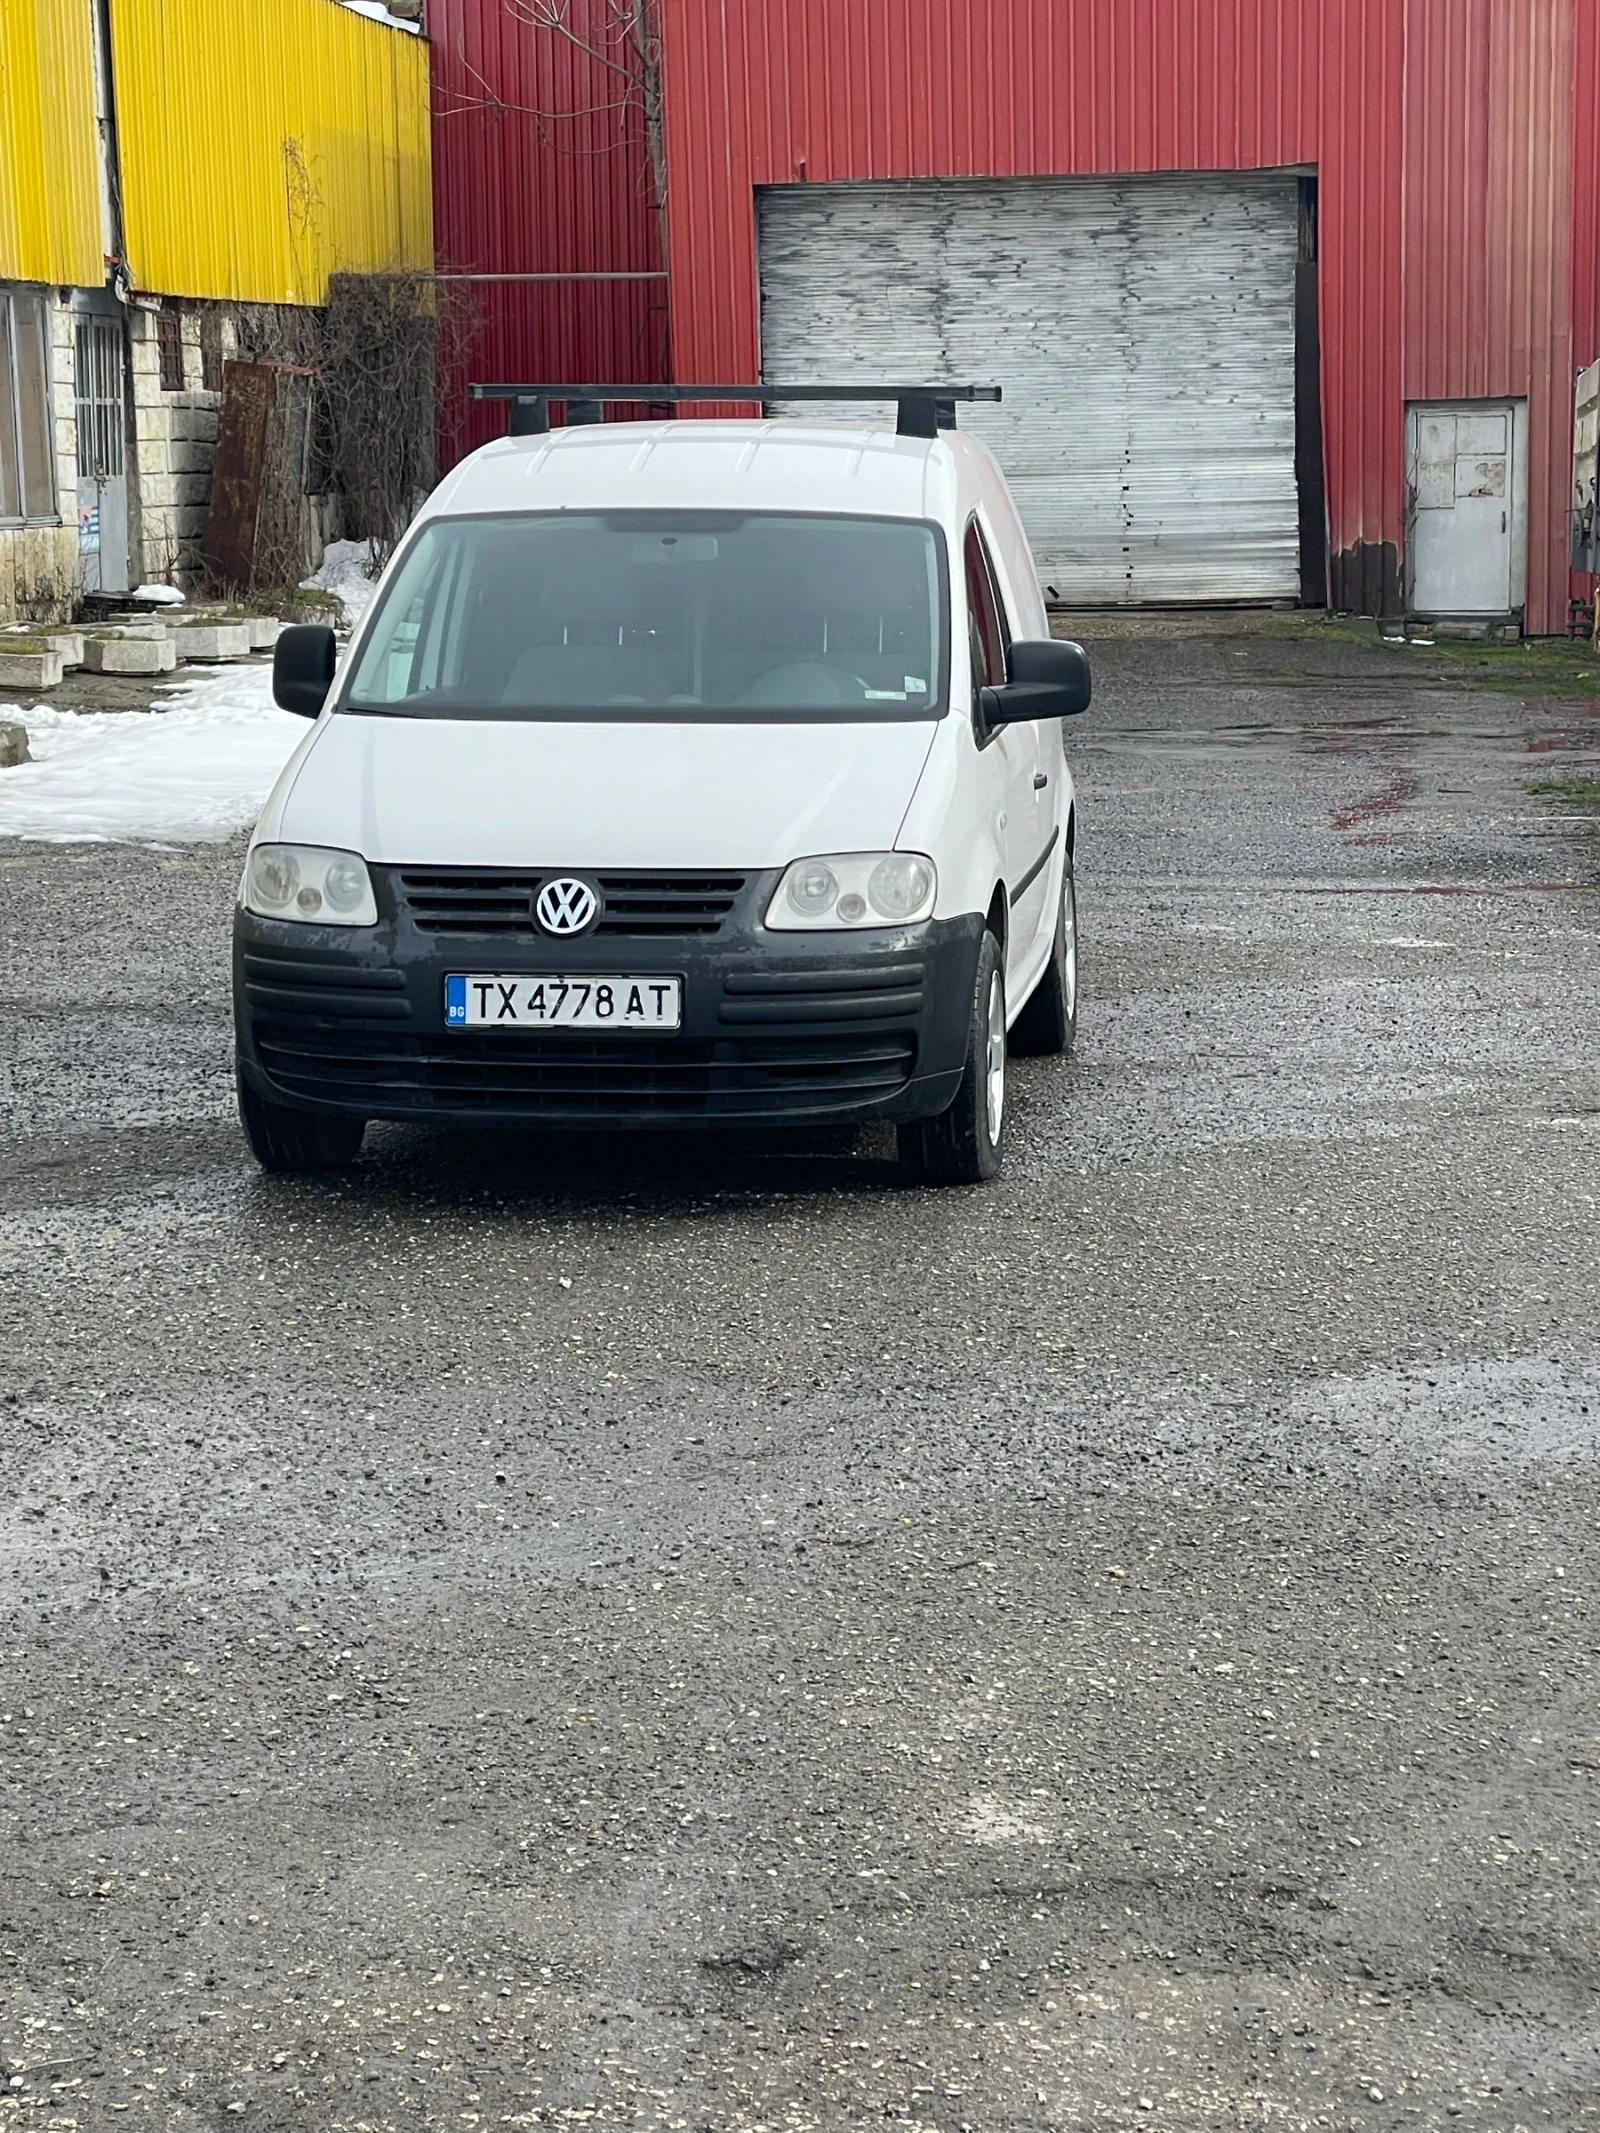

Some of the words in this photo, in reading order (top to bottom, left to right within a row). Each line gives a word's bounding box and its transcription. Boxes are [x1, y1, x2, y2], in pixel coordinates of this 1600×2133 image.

[538, 879, 595, 933] VW
[450, 1006, 464, 1018] BG
[527, 984, 614, 1019] 4778
